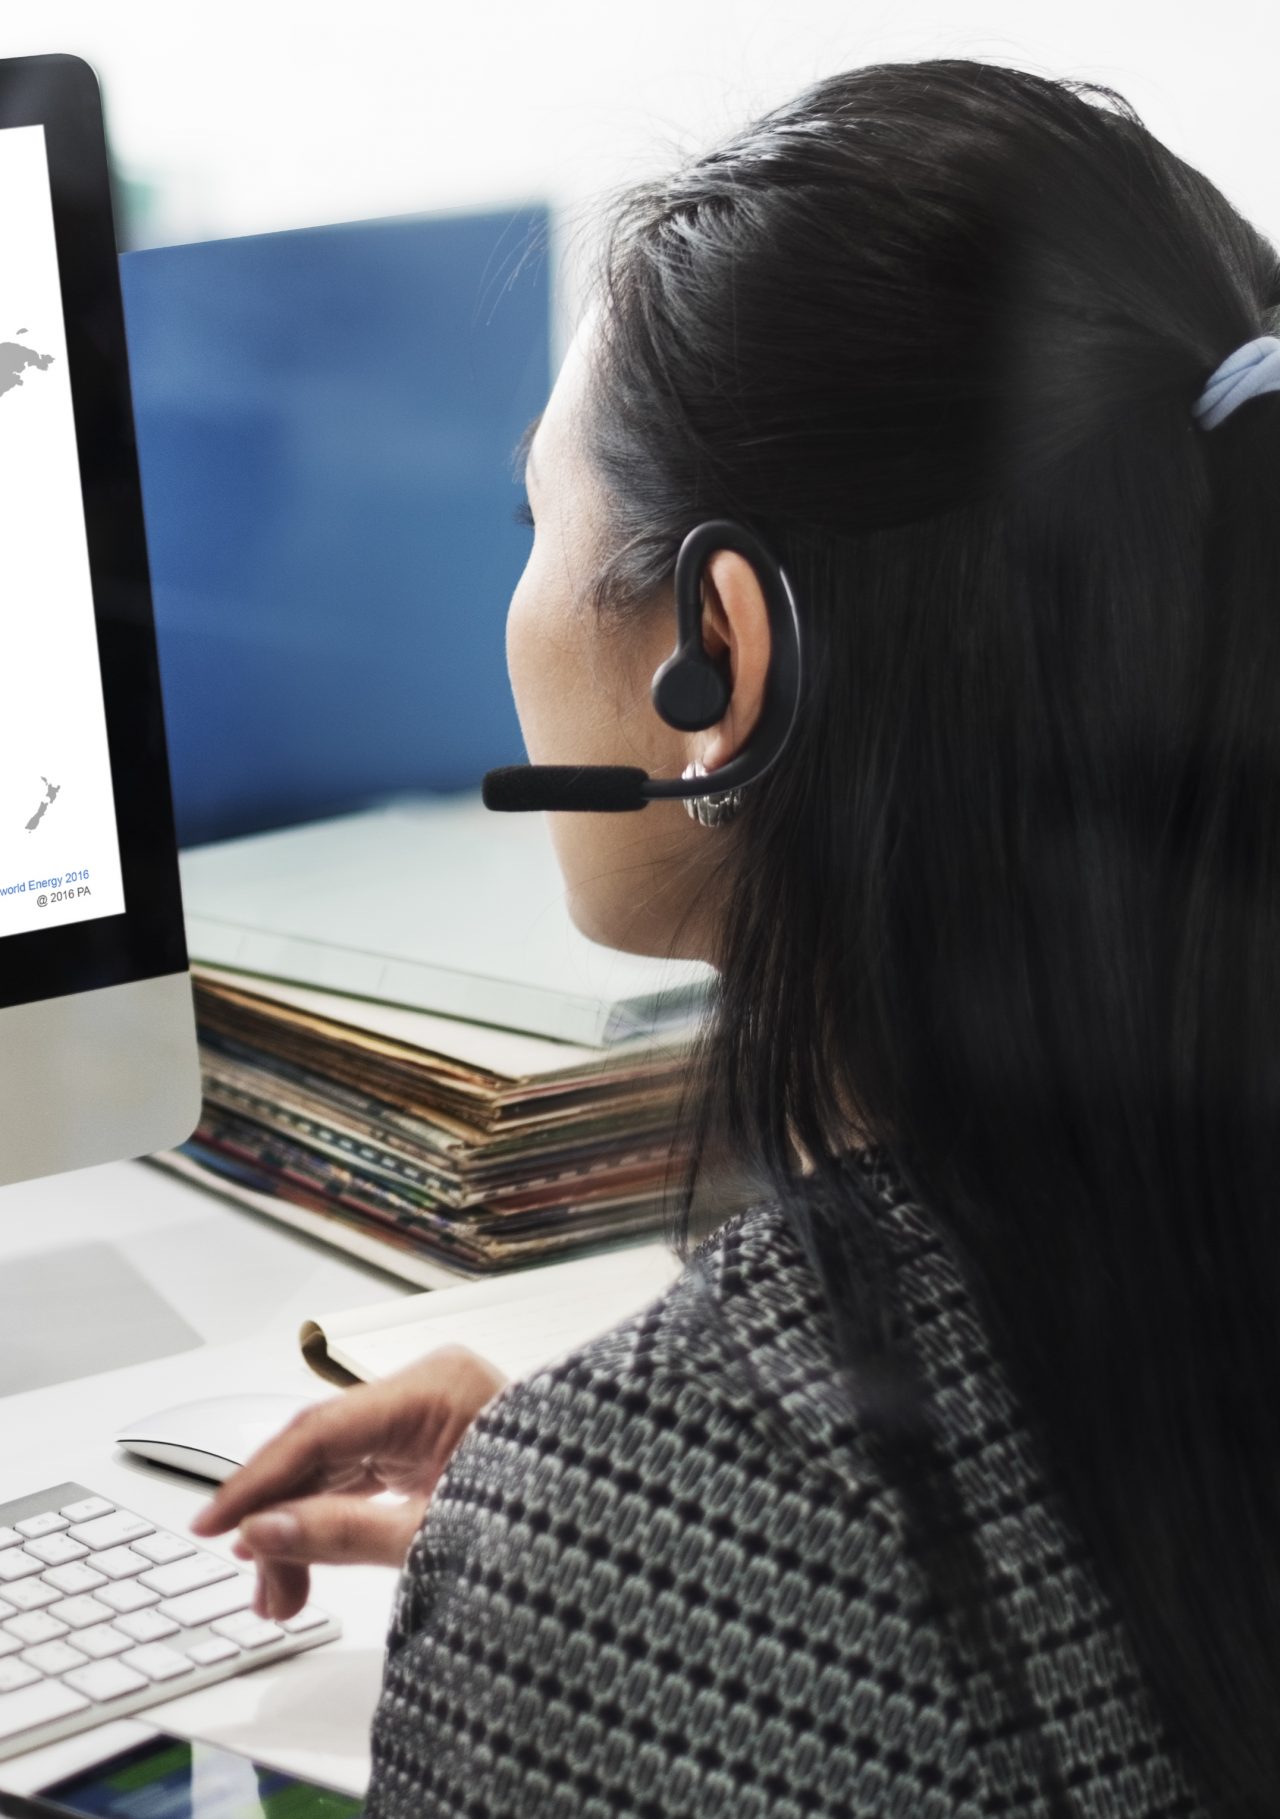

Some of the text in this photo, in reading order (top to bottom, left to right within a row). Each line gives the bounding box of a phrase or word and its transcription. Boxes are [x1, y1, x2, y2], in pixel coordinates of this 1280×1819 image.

[0, 882, 26, 897] world
[28, 875, 63, 891] Energy
[65, 869, 91, 884] 2016
[50, 888, 75, 904] 2016
[76, 885, 92, 898] PA
